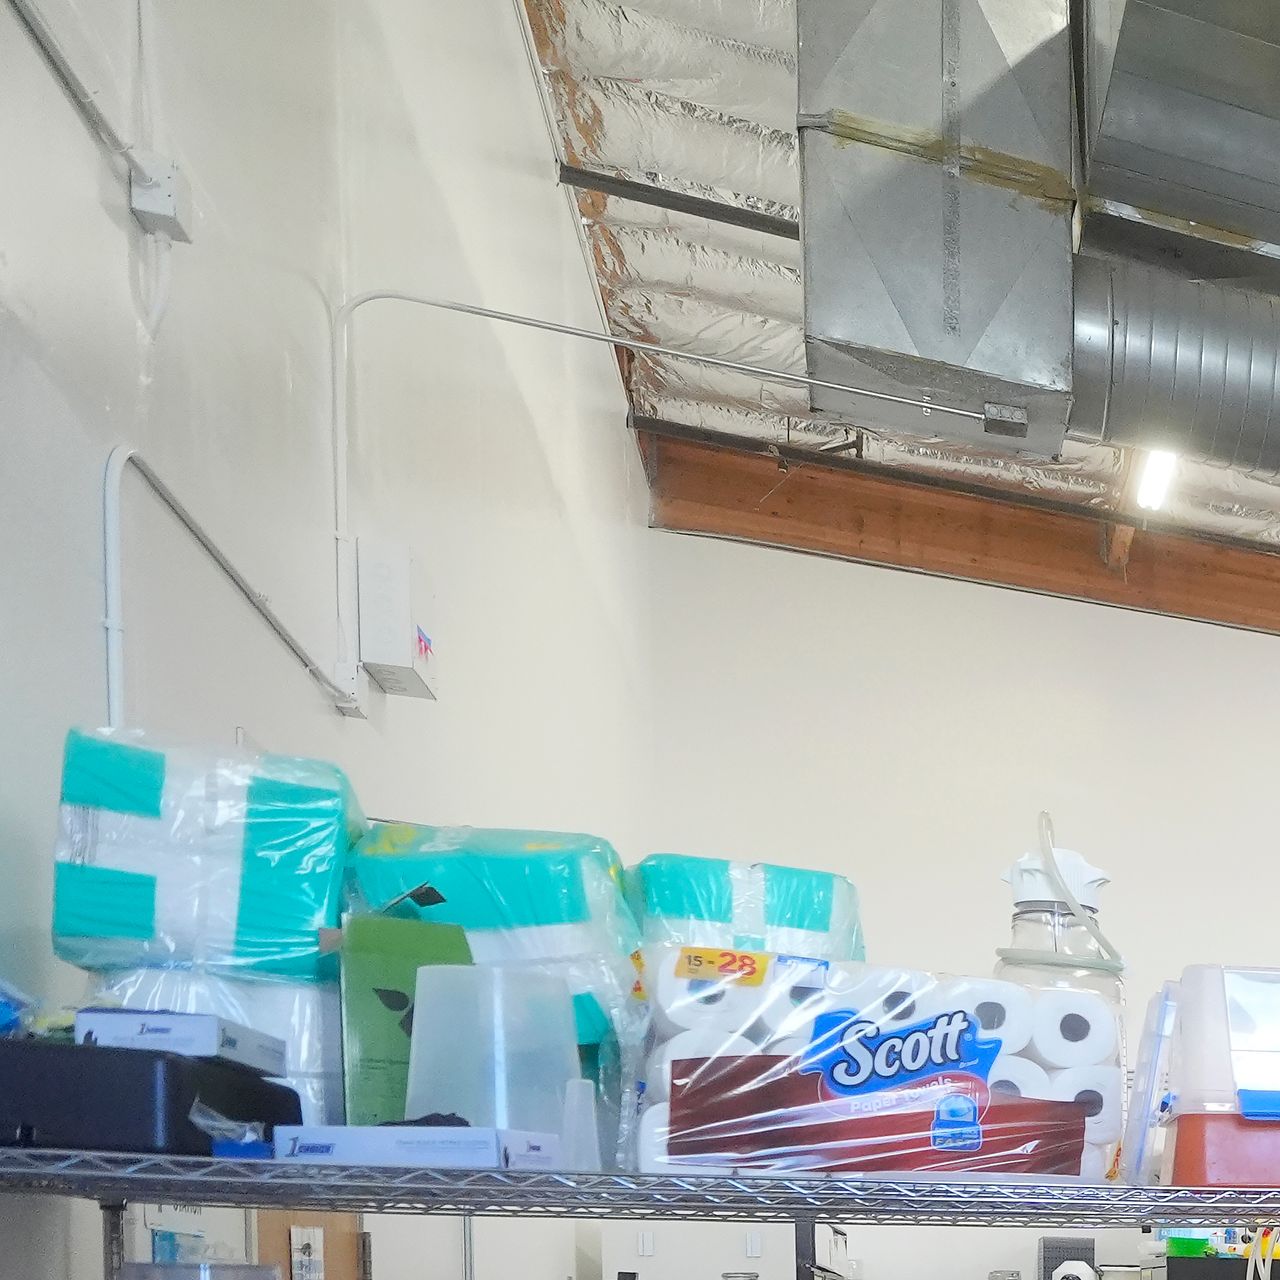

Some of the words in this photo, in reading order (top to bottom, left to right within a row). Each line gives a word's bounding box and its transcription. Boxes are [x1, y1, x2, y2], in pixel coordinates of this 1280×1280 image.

[686, 955, 703, 968] 15
[717, 952, 756, 977] 28
[832, 1010, 969, 1088] Scott
[850, 1095, 899, 1113] Paper
[907, 1075, 952, 1100] Towels
